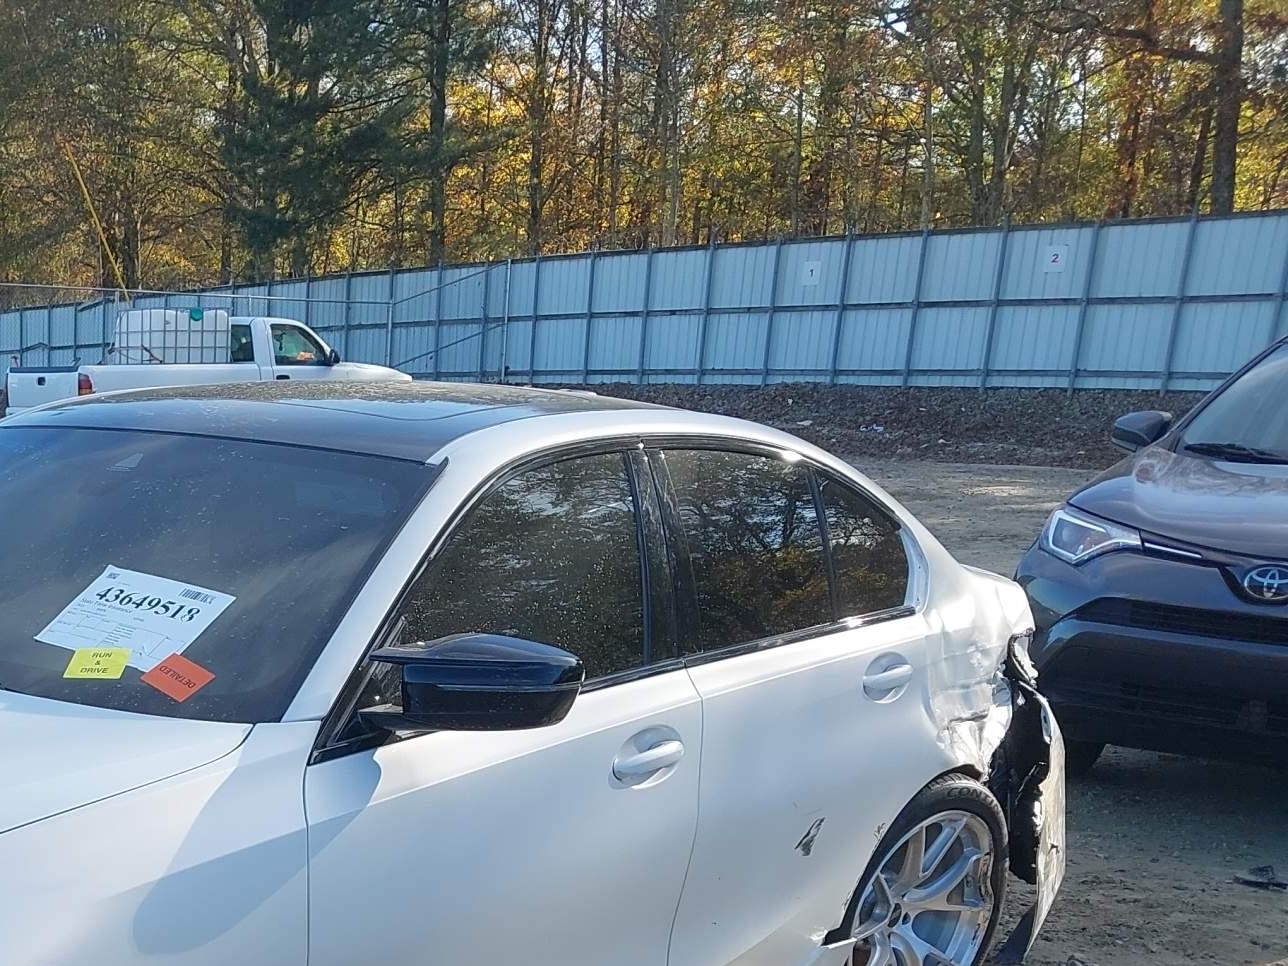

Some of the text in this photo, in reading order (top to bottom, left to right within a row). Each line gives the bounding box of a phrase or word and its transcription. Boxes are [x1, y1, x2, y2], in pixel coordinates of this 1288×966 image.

[1050, 253, 1059, 264] 2
[809, 268, 814, 278] 1
[96, 586, 201, 622] 43649518
[159, 665, 197, 689] DETAILED
